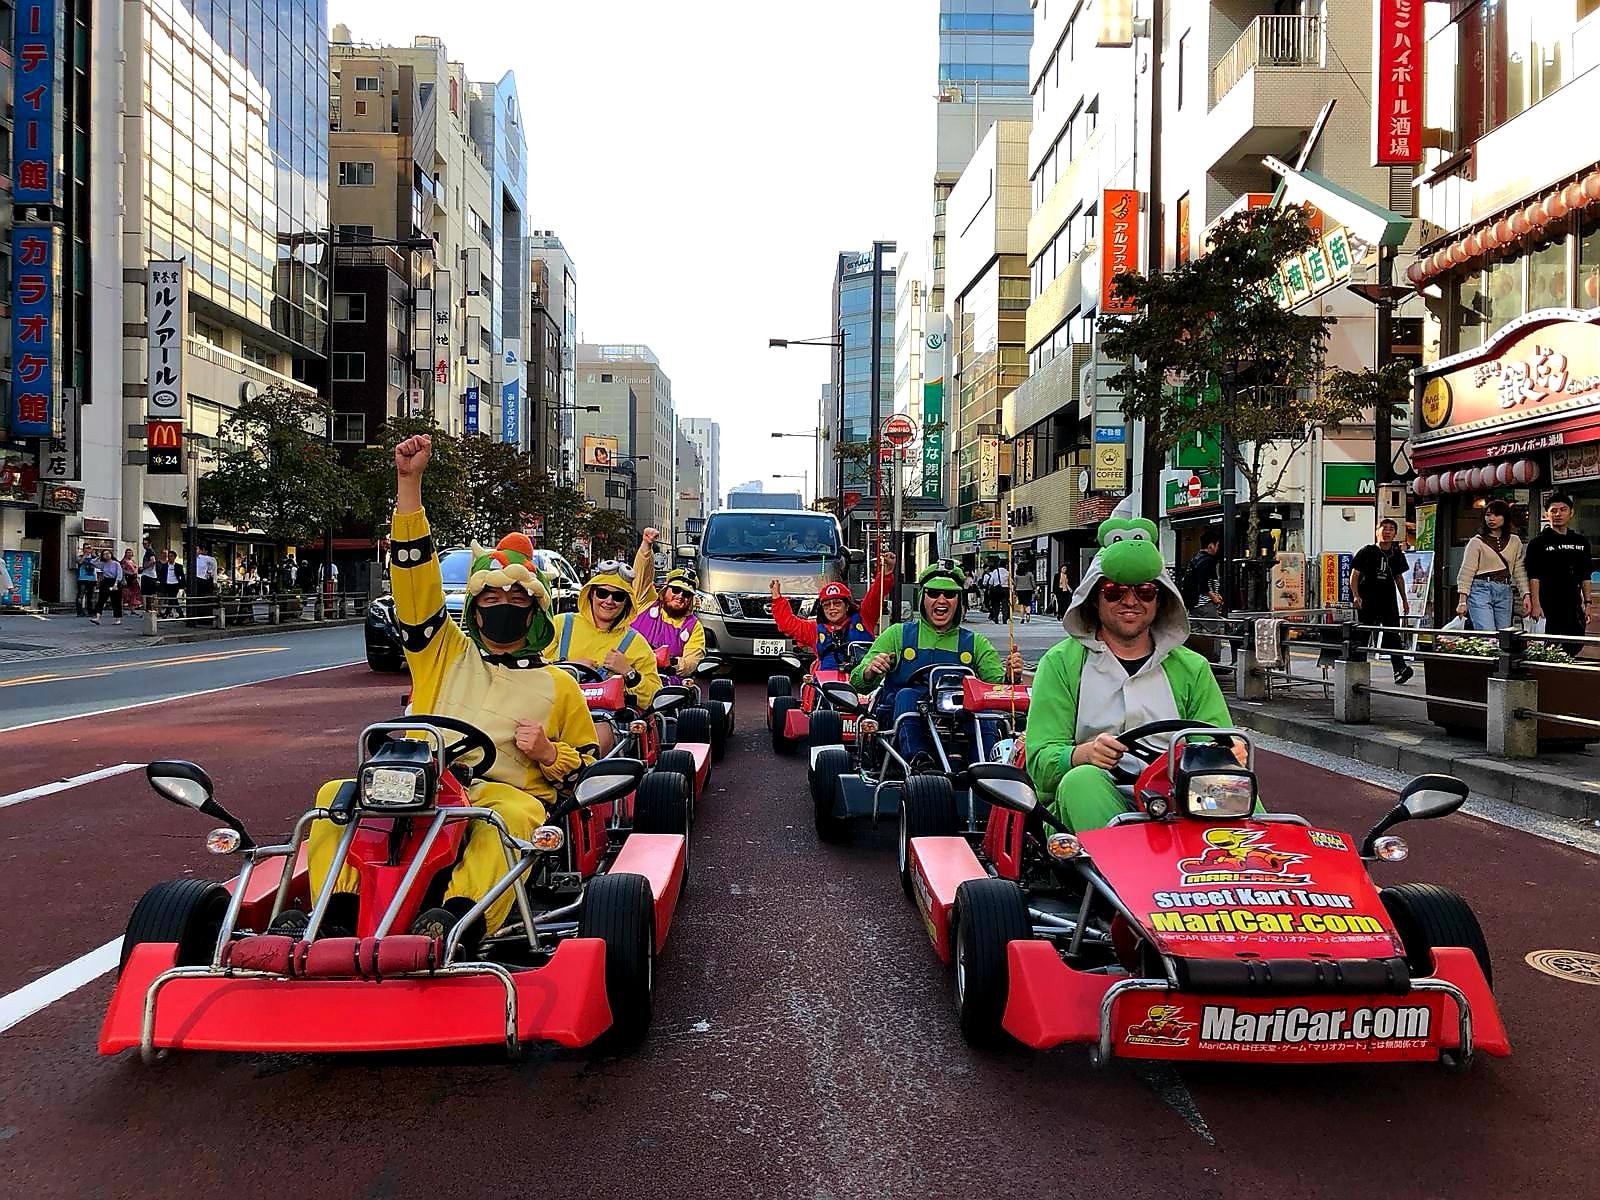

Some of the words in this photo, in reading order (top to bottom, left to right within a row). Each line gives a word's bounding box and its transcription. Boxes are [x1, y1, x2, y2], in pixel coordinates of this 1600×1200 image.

[18, 236, 49, 424] カラオケ館
[154, 287, 178, 386] ルノアール
[613, 375, 650, 385] Richmond
[925, 413, 940, 492] りそな銀行
[1486, 432, 1564, 457] ギンダコハイボール酒場
[165, 455, 178, 465] 24
[1154, 889, 1234, 908] Street
[1236, 888, 1292, 906] Kart
[1293, 889, 1353, 908] Tour
[1150, 909, 1384, 933] MariCar.com
[1201, 1005, 1430, 1042] MariCar.com
[1198, 1042, 1240, 1051] MariCAR
